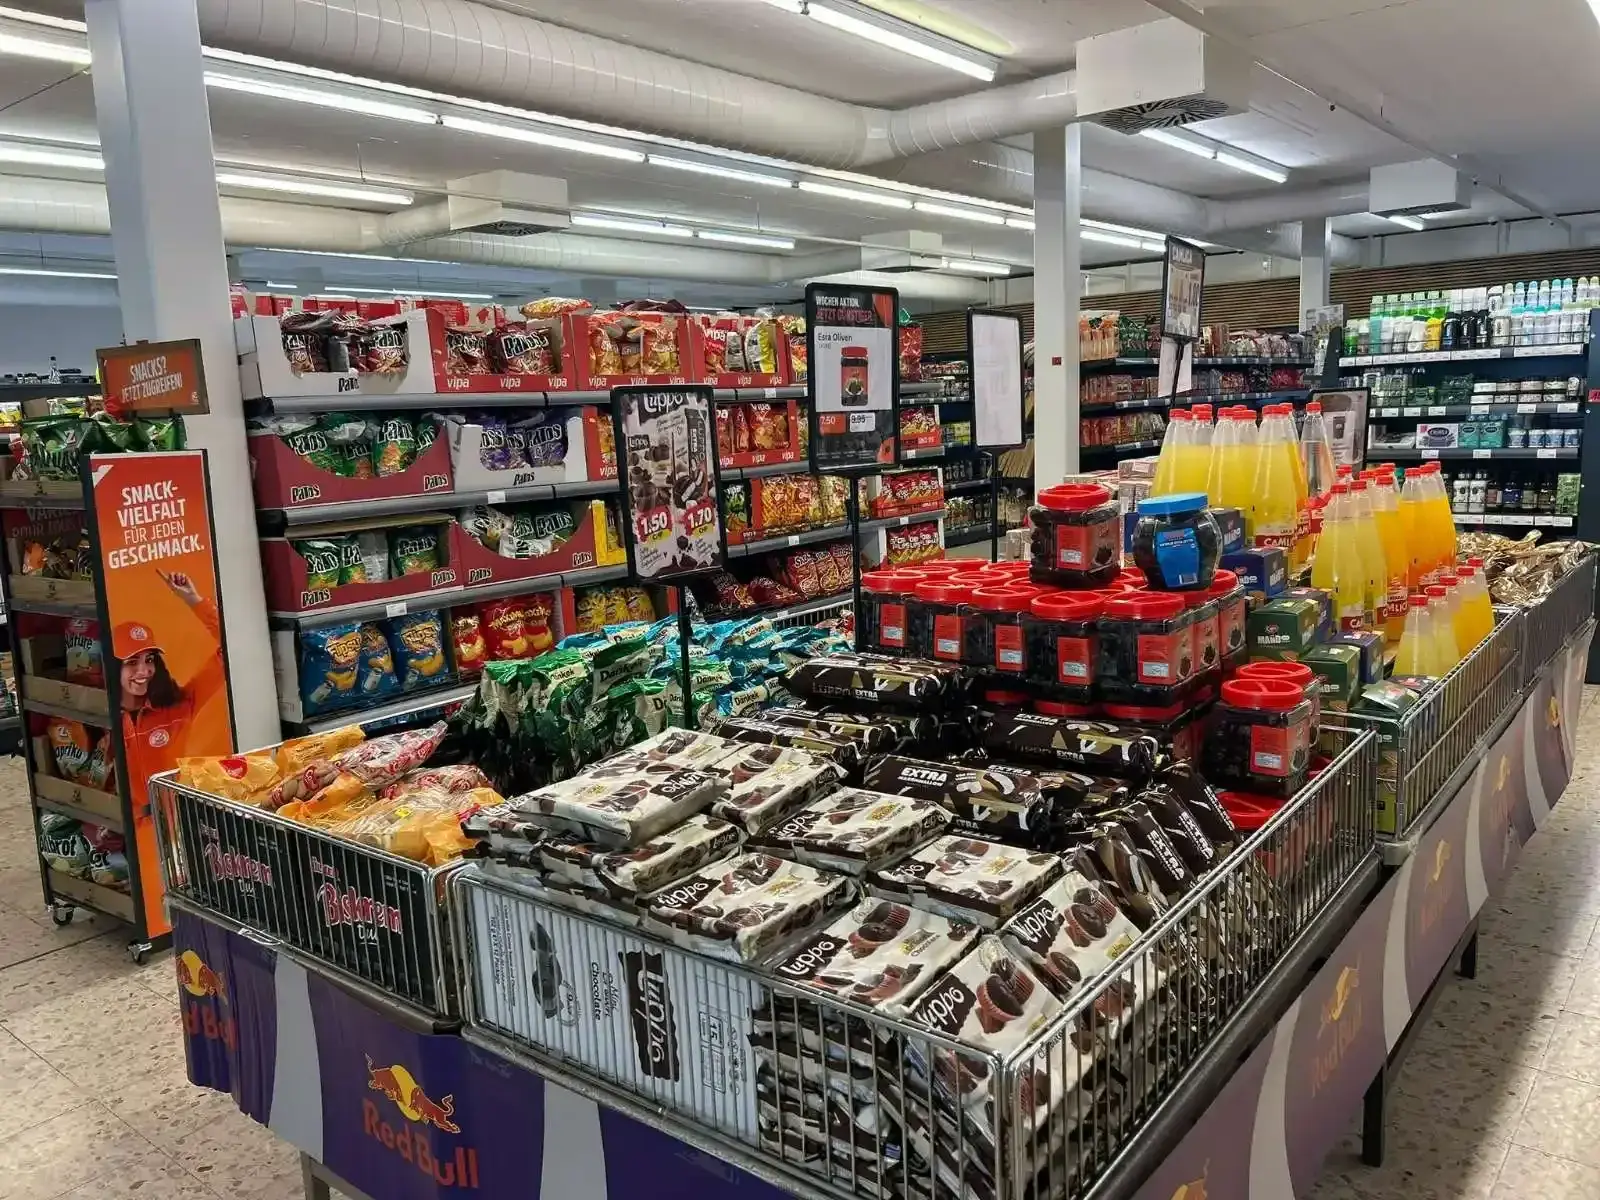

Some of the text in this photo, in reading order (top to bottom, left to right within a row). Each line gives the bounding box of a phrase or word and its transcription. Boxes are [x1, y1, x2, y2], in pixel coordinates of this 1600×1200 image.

[818, 333, 852, 342] Esra Oliven
[130, 355, 168, 382] SNACKS?
[338, 378, 360, 392] Pato
[447, 376, 469, 390] vipa
[500, 376, 520, 390] vipa
[548, 376, 567, 388] vipa
[588, 376, 606, 390] vipa
[704, 376, 718, 386] vipa
[737, 376, 752, 386] vipa
[769, 375, 782, 385] vipa
[644, 393, 683, 413] Luppo
[720, 456, 734, 466] vipa
[752, 453, 766, 464] vipa
[781, 452, 794, 461] vipa
[121, 480, 179, 506] SNACK-
[291, 485, 320, 504] Patos
[116, 498, 186, 528] VIELFALT
[640, 512, 668, 533] 1.50
[687, 506, 712, 528] 1.70
[124, 519, 185, 545] FÜR JEDEN
[108, 534, 205, 570] GESCHMACK.
[301, 588, 331, 608] Patos
[854, 688, 878, 700] EXTRA
[1016, 713, 1059, 724] EXTRA
[901, 768, 948, 782] EXTRA
[656, 880, 710, 908] Luppo
[318, 882, 402, 934] Biskrem
[1010, 906, 1058, 944] Luppo
[780, 940, 835, 976] Luppo
[592, 961, 601, 1020] Chocolate
[362, 1096, 480, 1189] Red Bull
